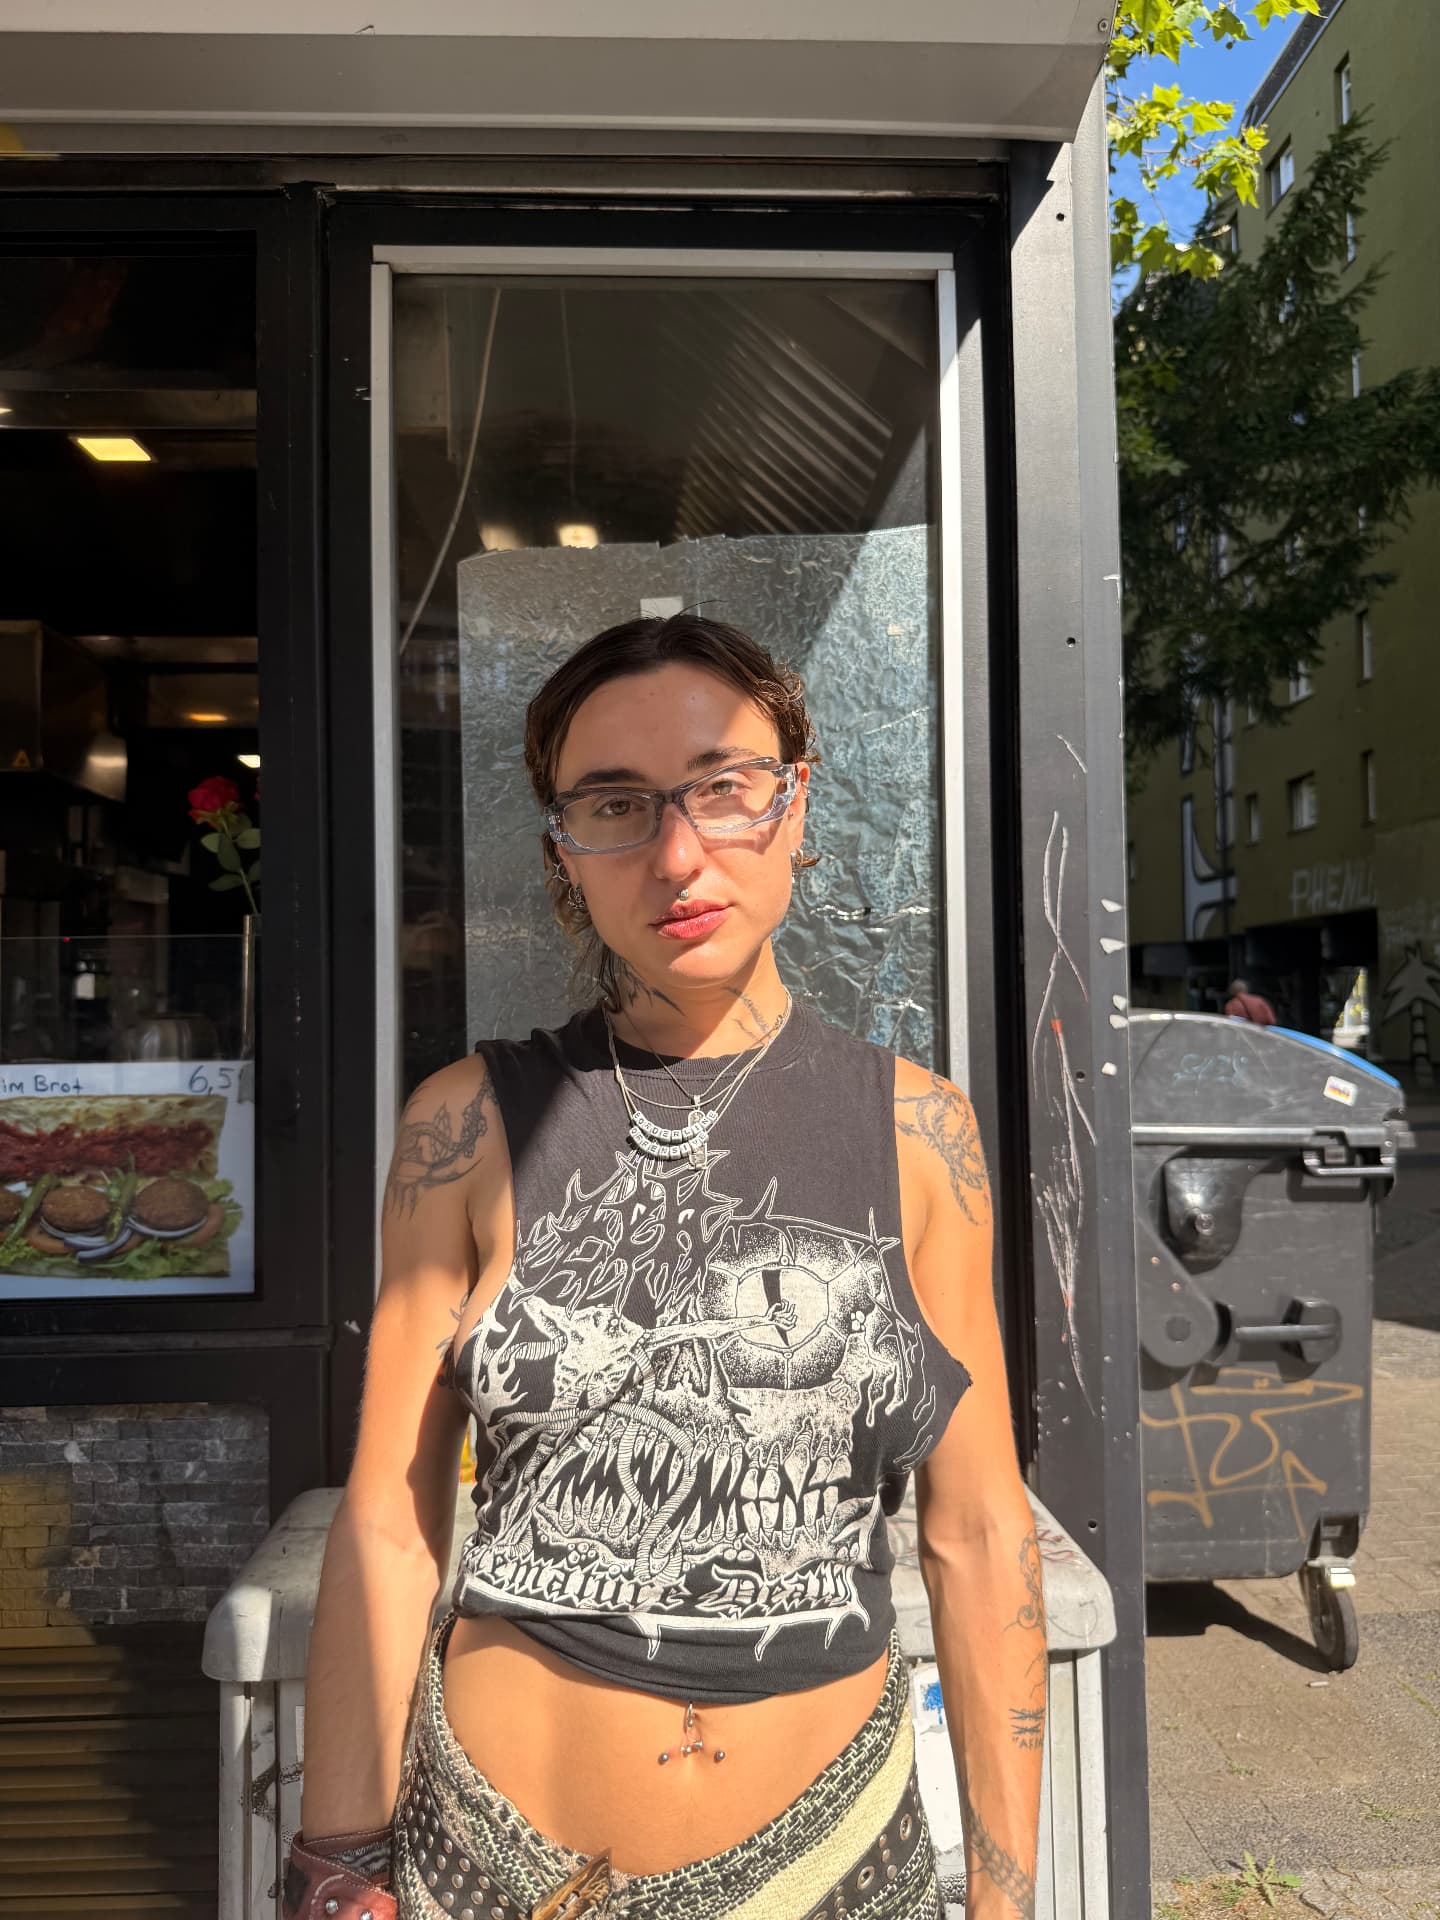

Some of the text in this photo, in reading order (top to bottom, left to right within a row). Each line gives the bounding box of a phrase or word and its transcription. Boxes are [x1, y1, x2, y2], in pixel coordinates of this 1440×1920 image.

[34, 1074, 84, 1094] Brot
[188, 1065, 244, 1095] 6,5
[633, 1110, 718, 1140] BORDERLINE
[630, 1127, 708, 1157] OFFENSIVE
[695, 1561, 854, 1619] Death
